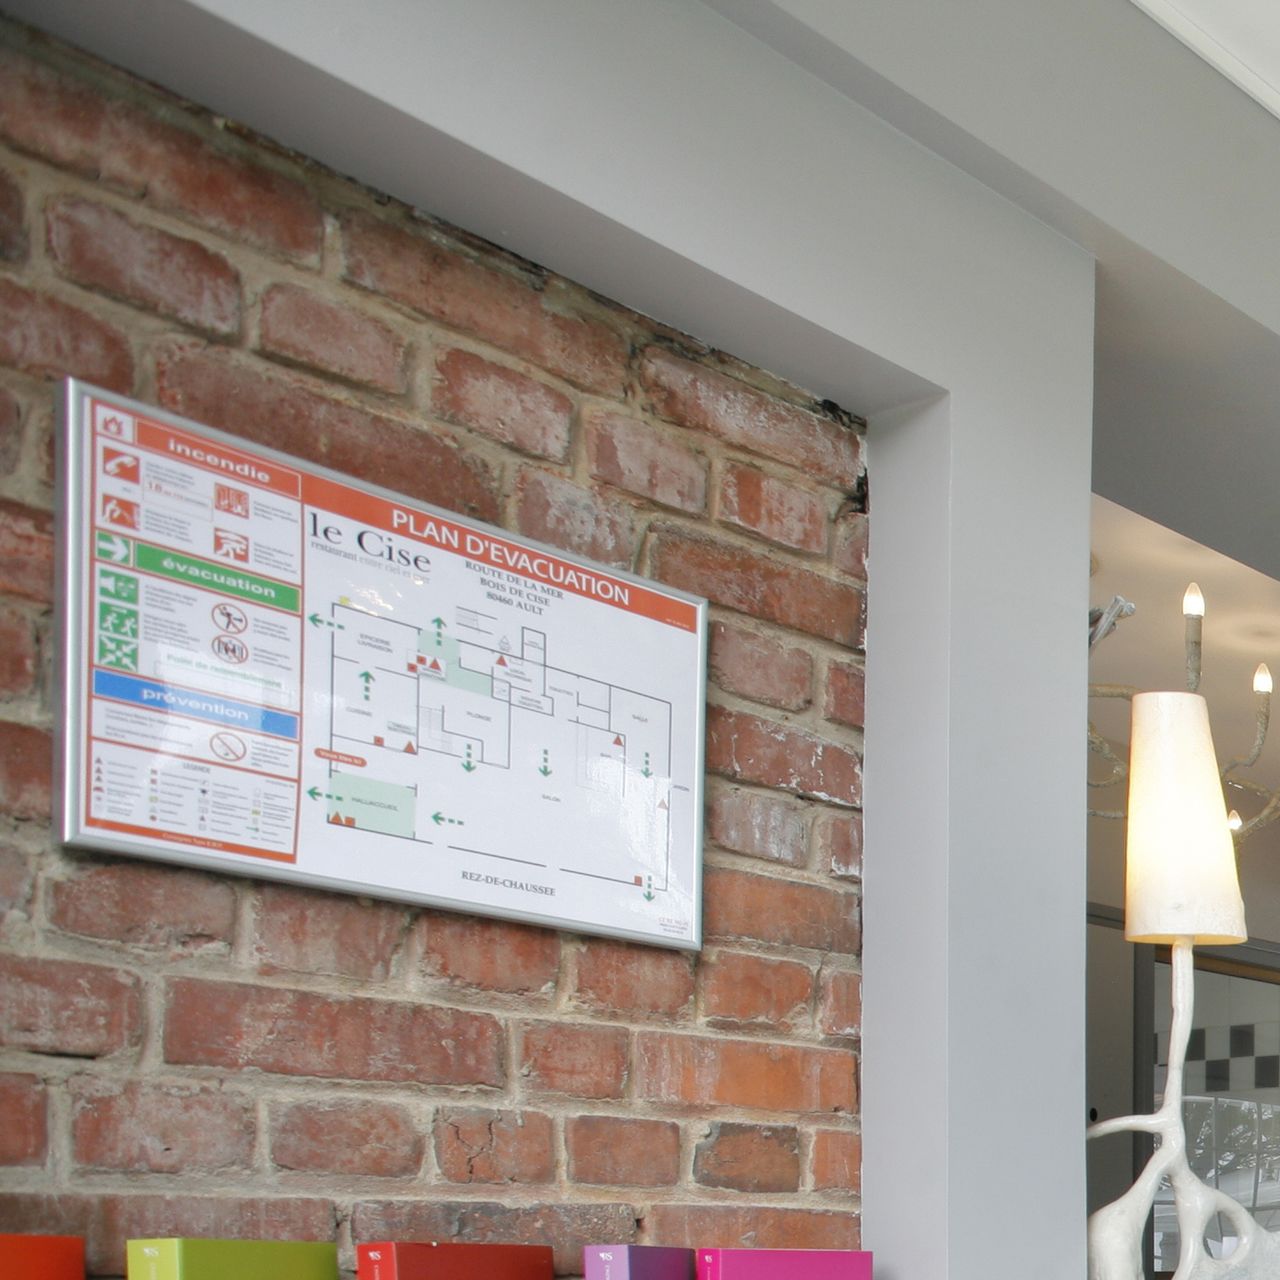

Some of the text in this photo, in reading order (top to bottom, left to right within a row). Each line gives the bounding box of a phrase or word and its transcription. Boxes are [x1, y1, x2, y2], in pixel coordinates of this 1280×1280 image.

[168, 437, 270, 483] incendie
[309, 511, 343, 546] le
[356, 528, 432, 574] Cise
[310, 540, 358, 563] restaurant
[391, 509, 631, 606] PLAN D'EVACUATION
[162, 556, 276, 599] évacuation
[464, 559, 565, 601] ROUTE DE LA MER
[479, 576, 552, 608] BOIS DE CISE
[516, 599, 545, 616] AULT
[141, 686, 250, 721] prévention
[460, 869, 558, 898] REZ-DE-CHAUSSEE
